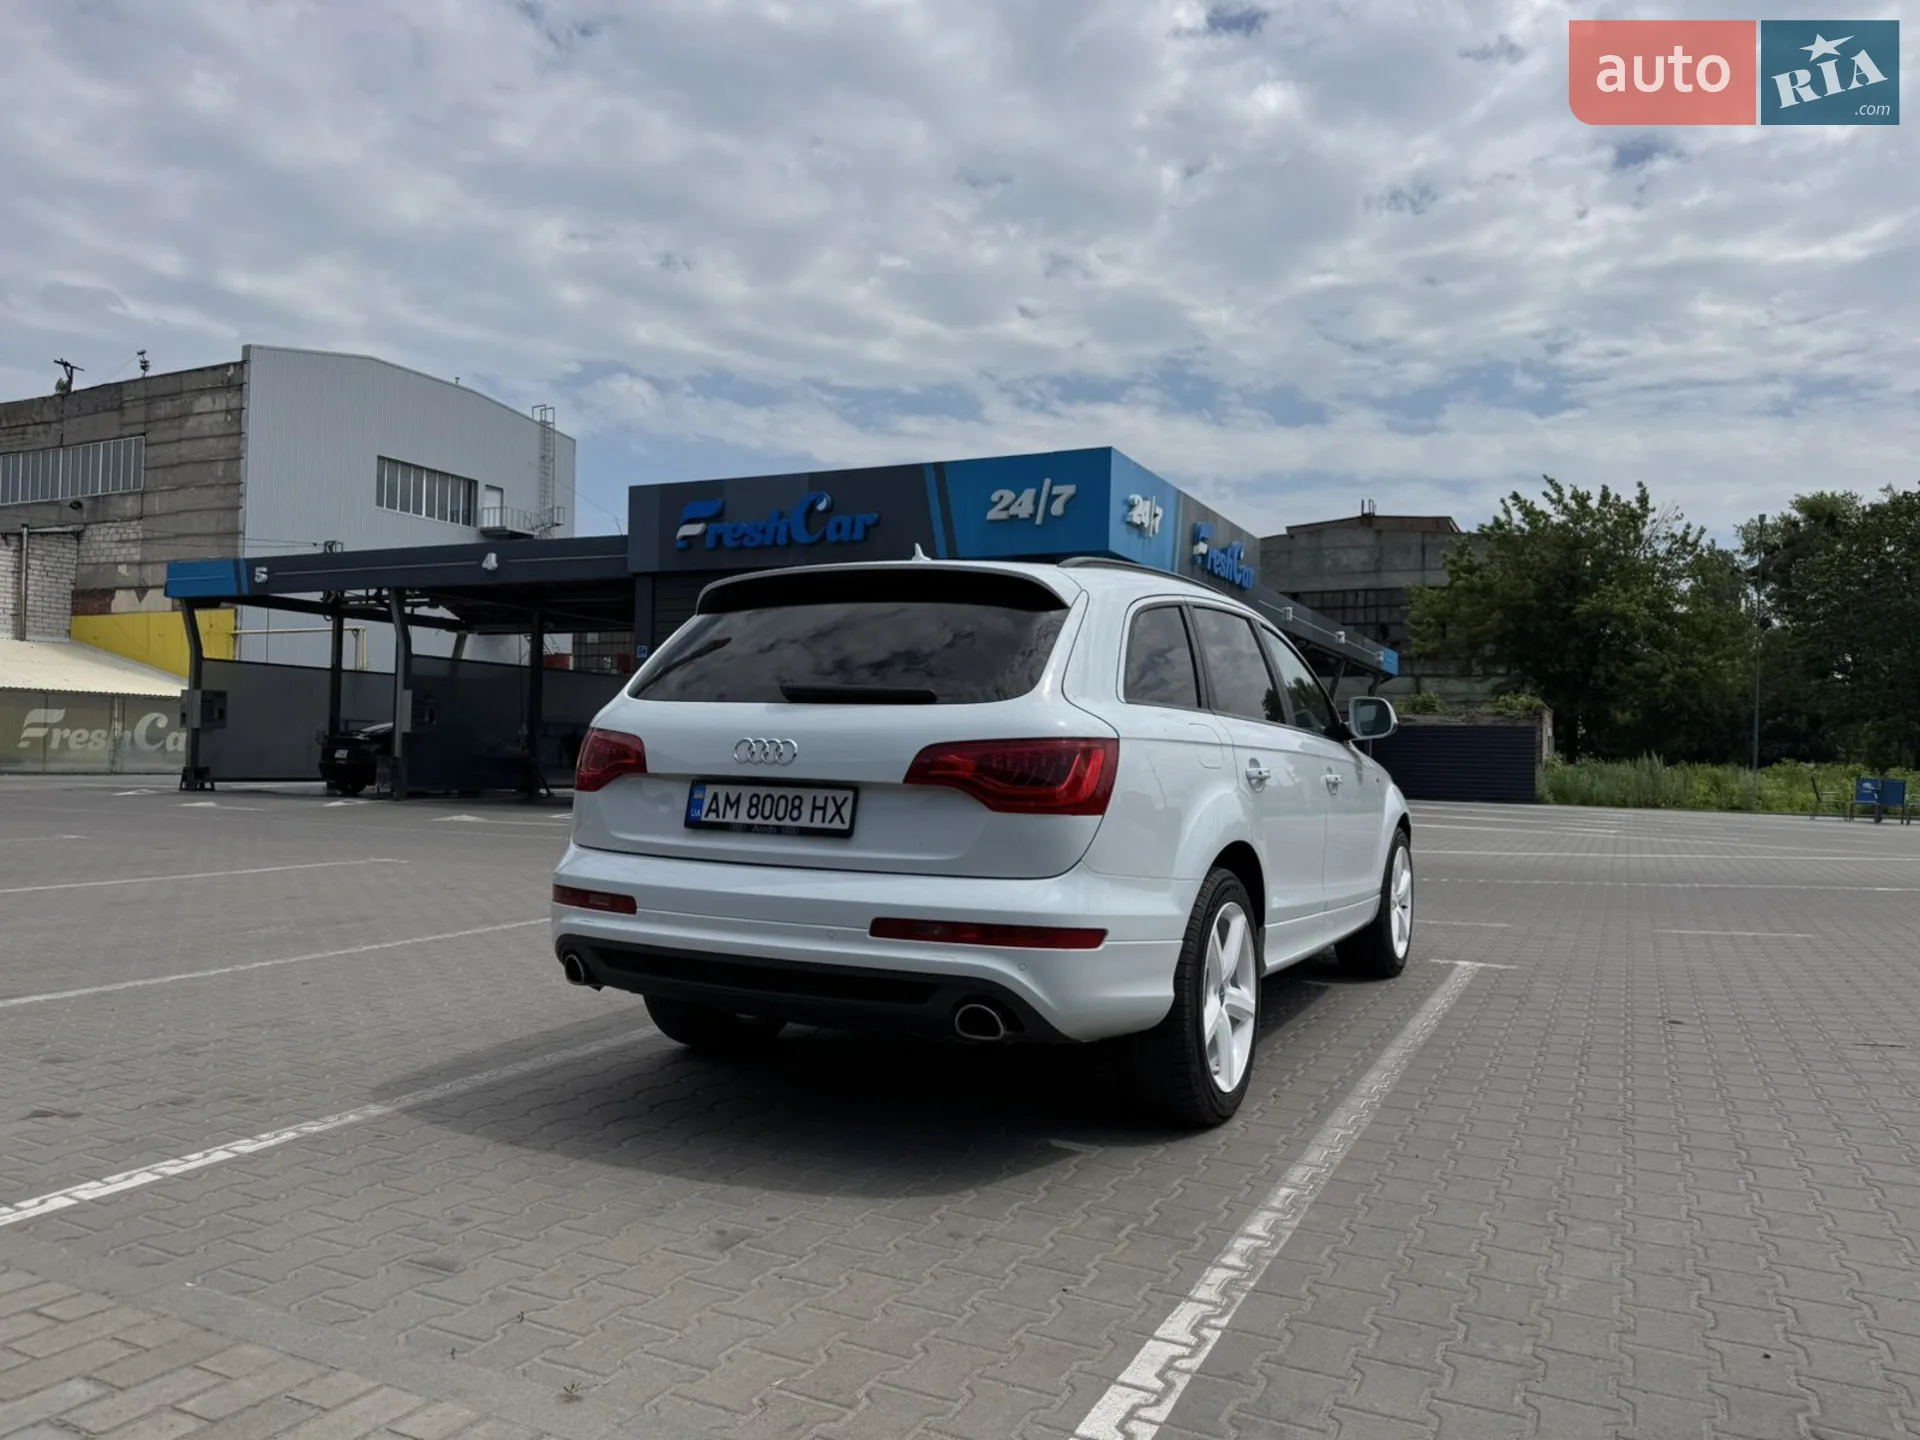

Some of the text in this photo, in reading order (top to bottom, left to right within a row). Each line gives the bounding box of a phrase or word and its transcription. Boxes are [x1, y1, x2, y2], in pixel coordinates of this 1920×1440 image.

[676, 491, 879, 550] FreshCar
[986, 477, 1077, 525] 24/7
[1126, 494, 1163, 538] 24/7
[254, 566, 269, 583] 5
[481, 552, 498, 571] 4
[1192, 521, 1256, 589] FreshCar
[17, 708, 188, 752] FreshCa
[704, 791, 849, 825] AM 8008 HX
